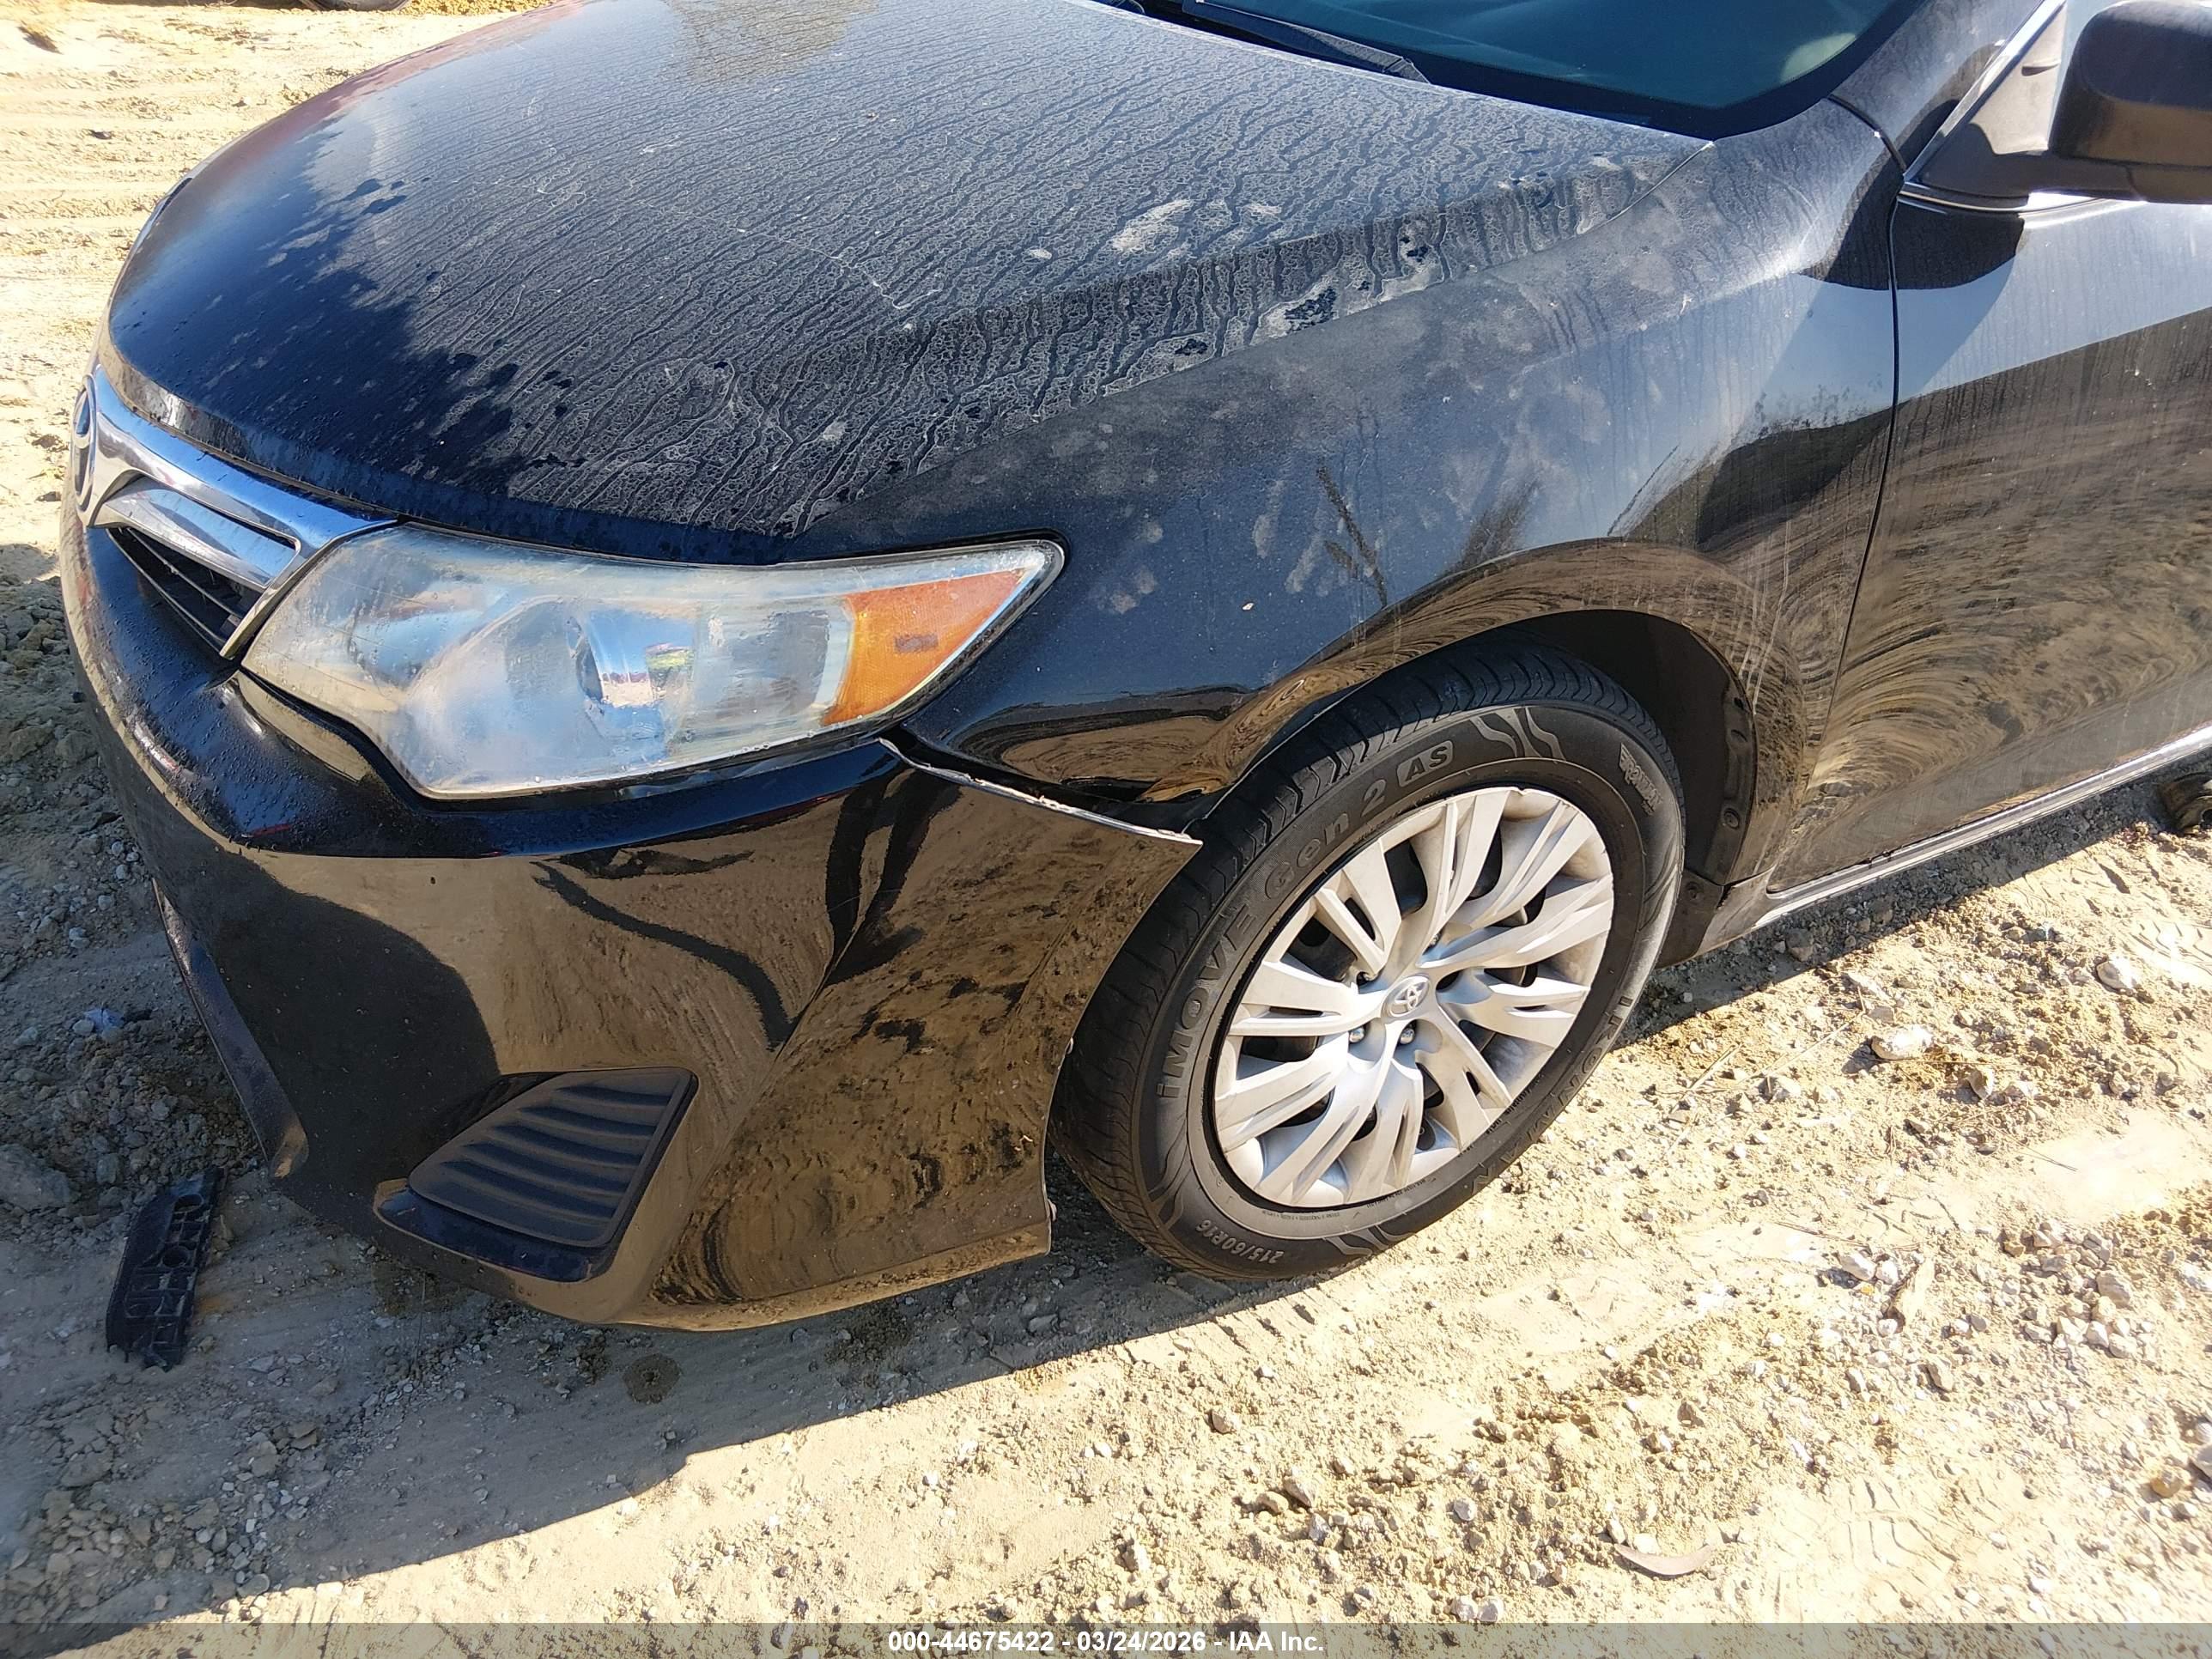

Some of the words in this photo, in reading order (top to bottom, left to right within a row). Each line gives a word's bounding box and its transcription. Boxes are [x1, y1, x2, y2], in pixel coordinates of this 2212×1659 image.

[1361, 779, 1387, 817] 2
[1407, 745, 1449, 782] AS
[1196, 1219, 1285, 1263] 215/60R16
